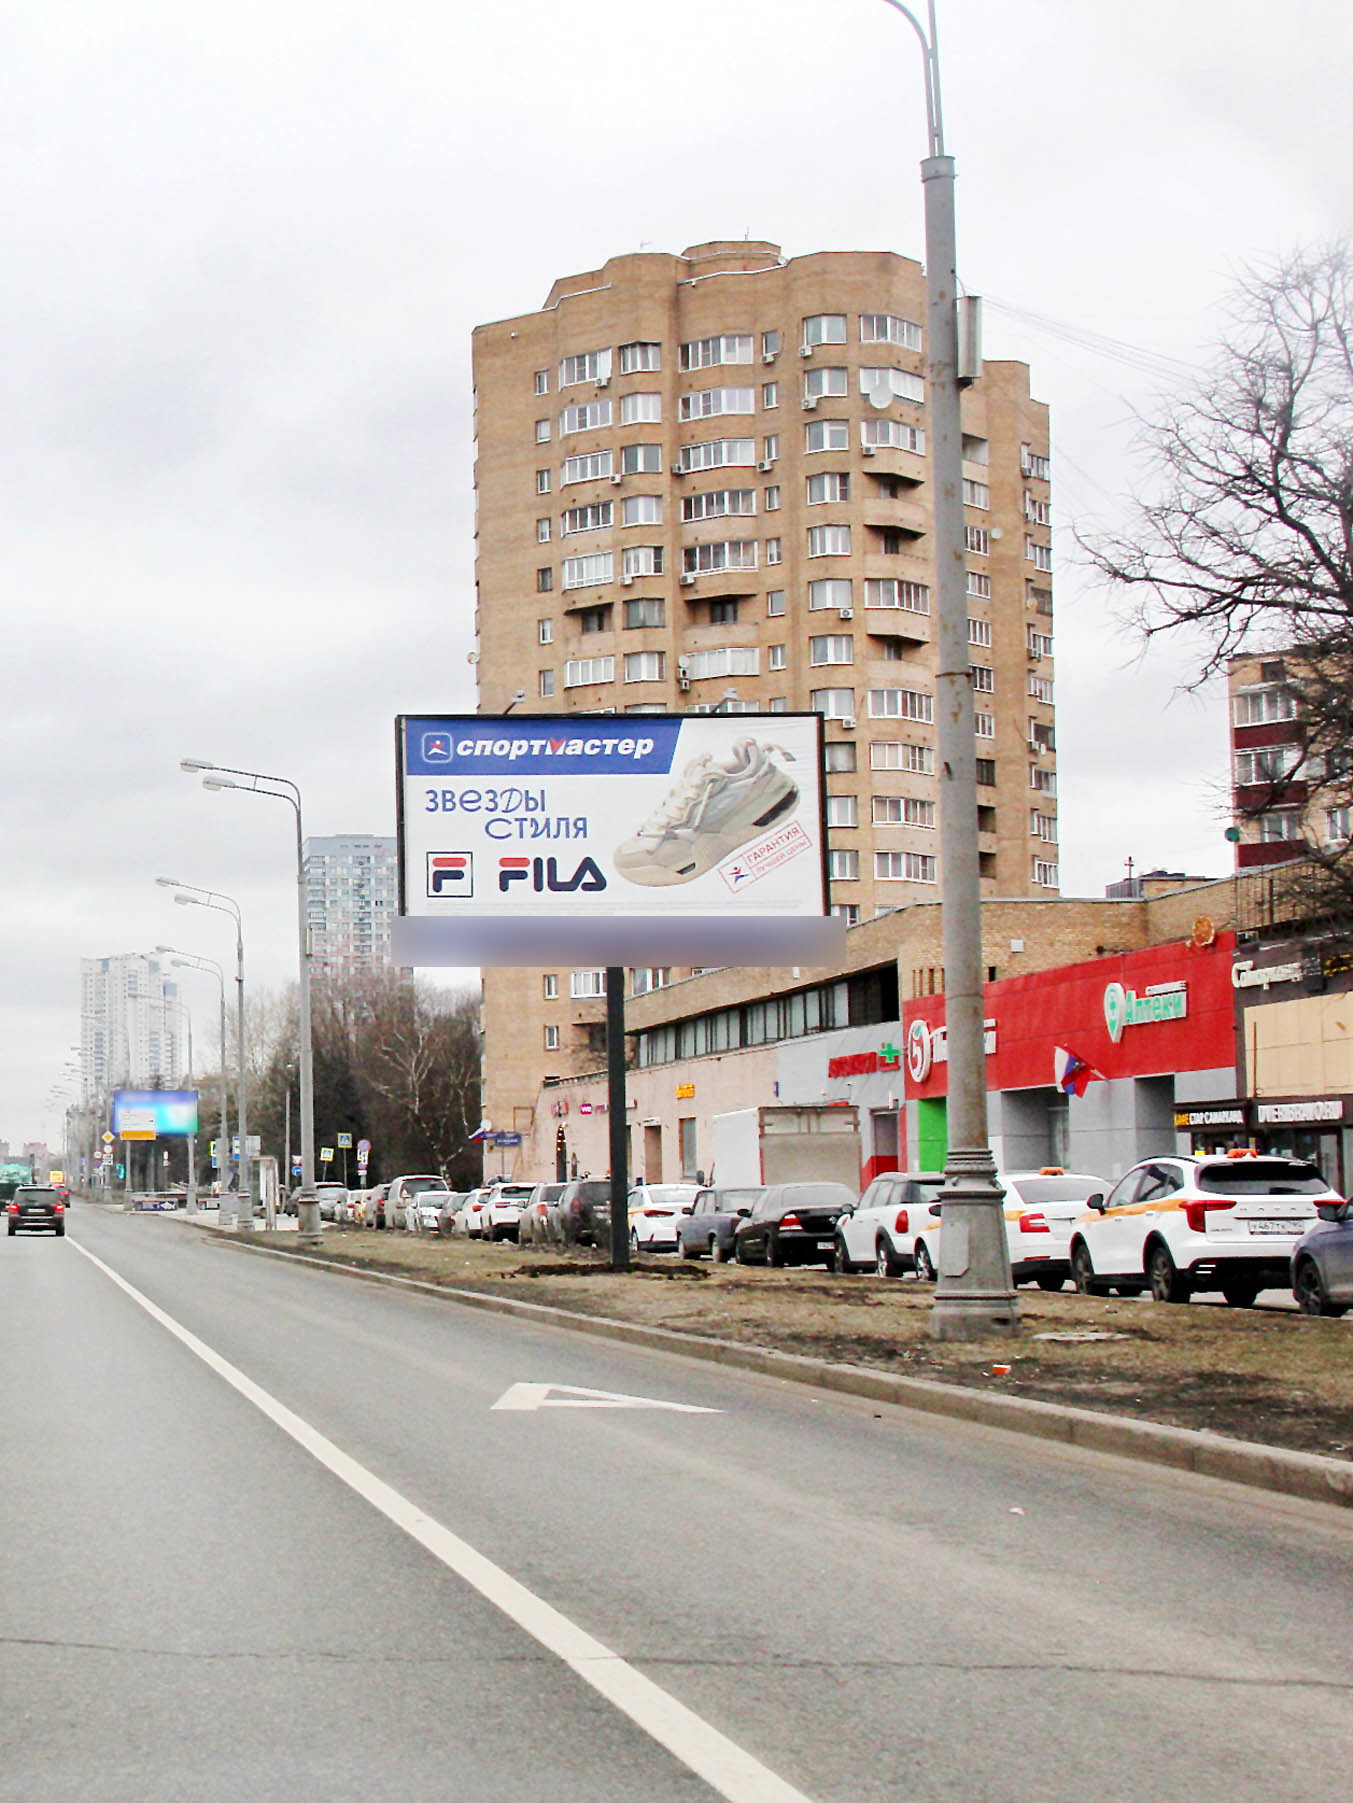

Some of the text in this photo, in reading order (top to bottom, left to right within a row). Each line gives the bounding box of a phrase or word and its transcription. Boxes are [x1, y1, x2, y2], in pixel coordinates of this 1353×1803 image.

[456, 736, 654, 760] спортмастер
[484, 817, 588, 840] СТИЛЯ
[746, 826, 801, 865] ГАРАНТИЯ
[499, 856, 607, 892] FILA
[1123, 990, 1187, 1026] Аптеки
